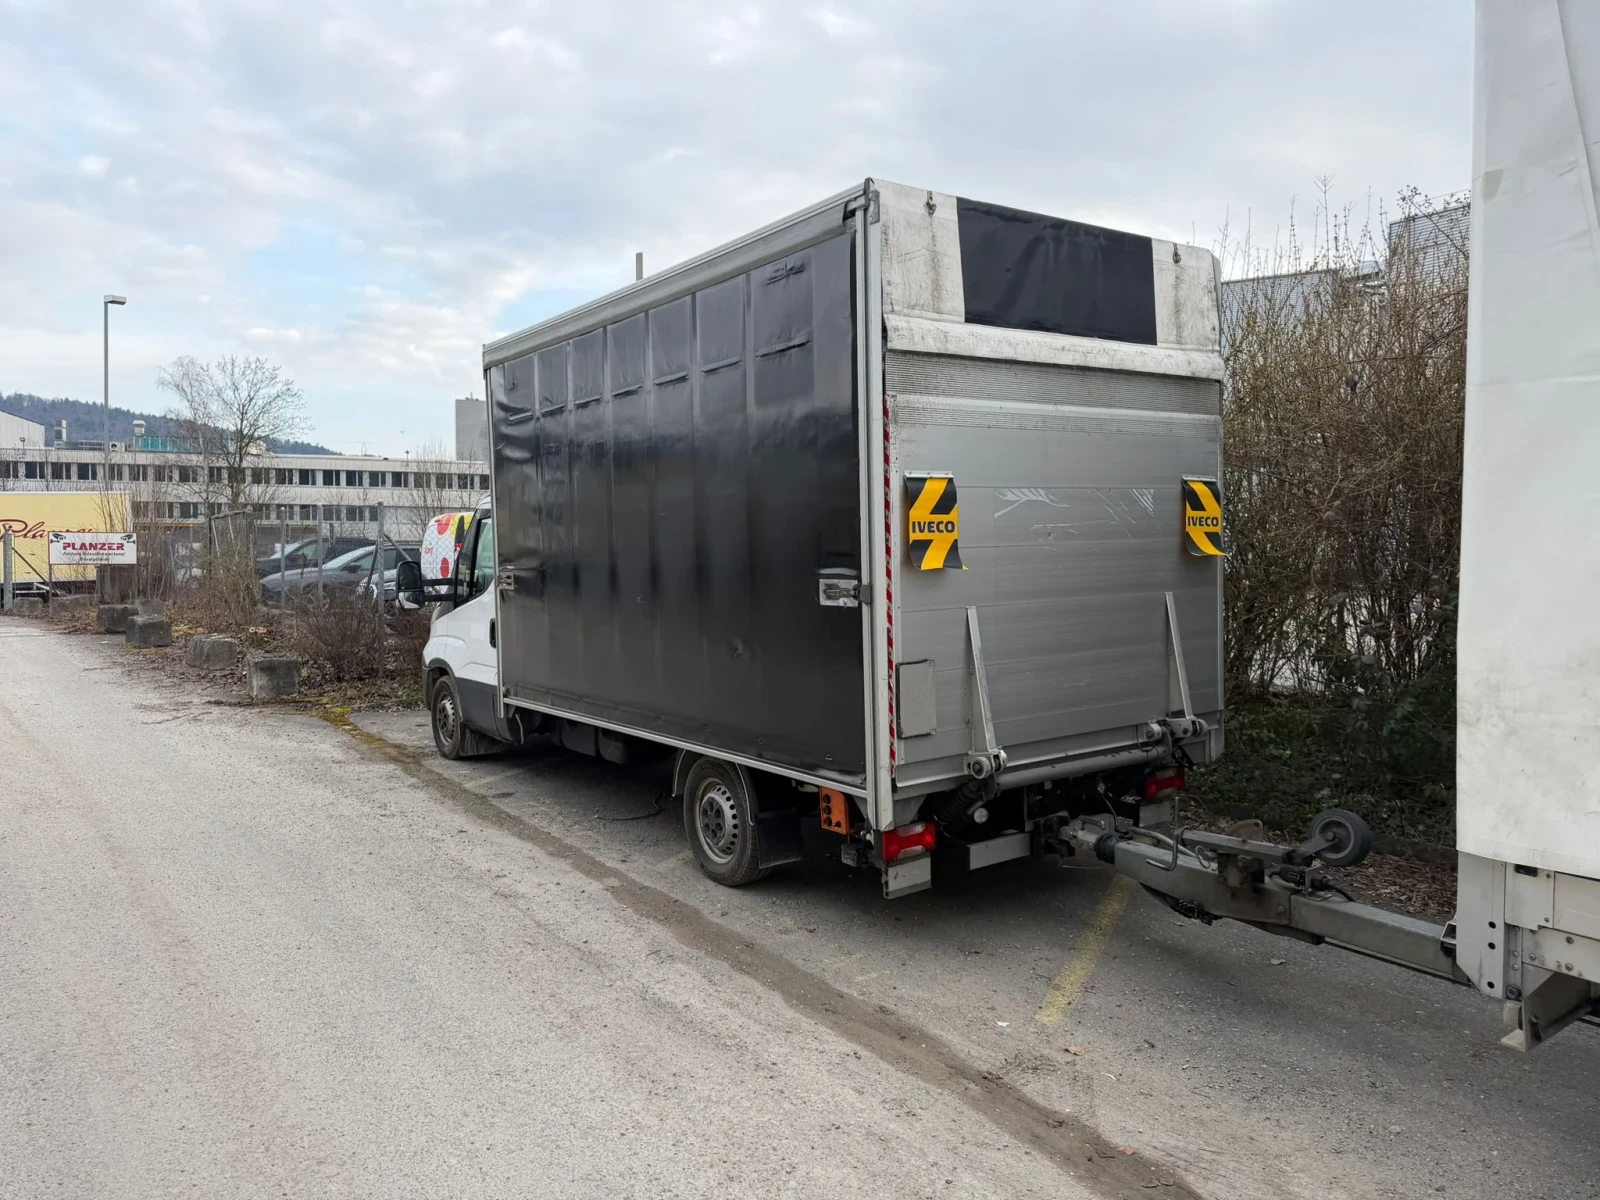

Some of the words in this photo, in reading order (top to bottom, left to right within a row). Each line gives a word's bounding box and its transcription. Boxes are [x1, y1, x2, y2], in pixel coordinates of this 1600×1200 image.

[911, 520, 956, 534] IVECO
[1187, 515, 1219, 527] IVECO
[62, 542, 125, 551] PLANZER
